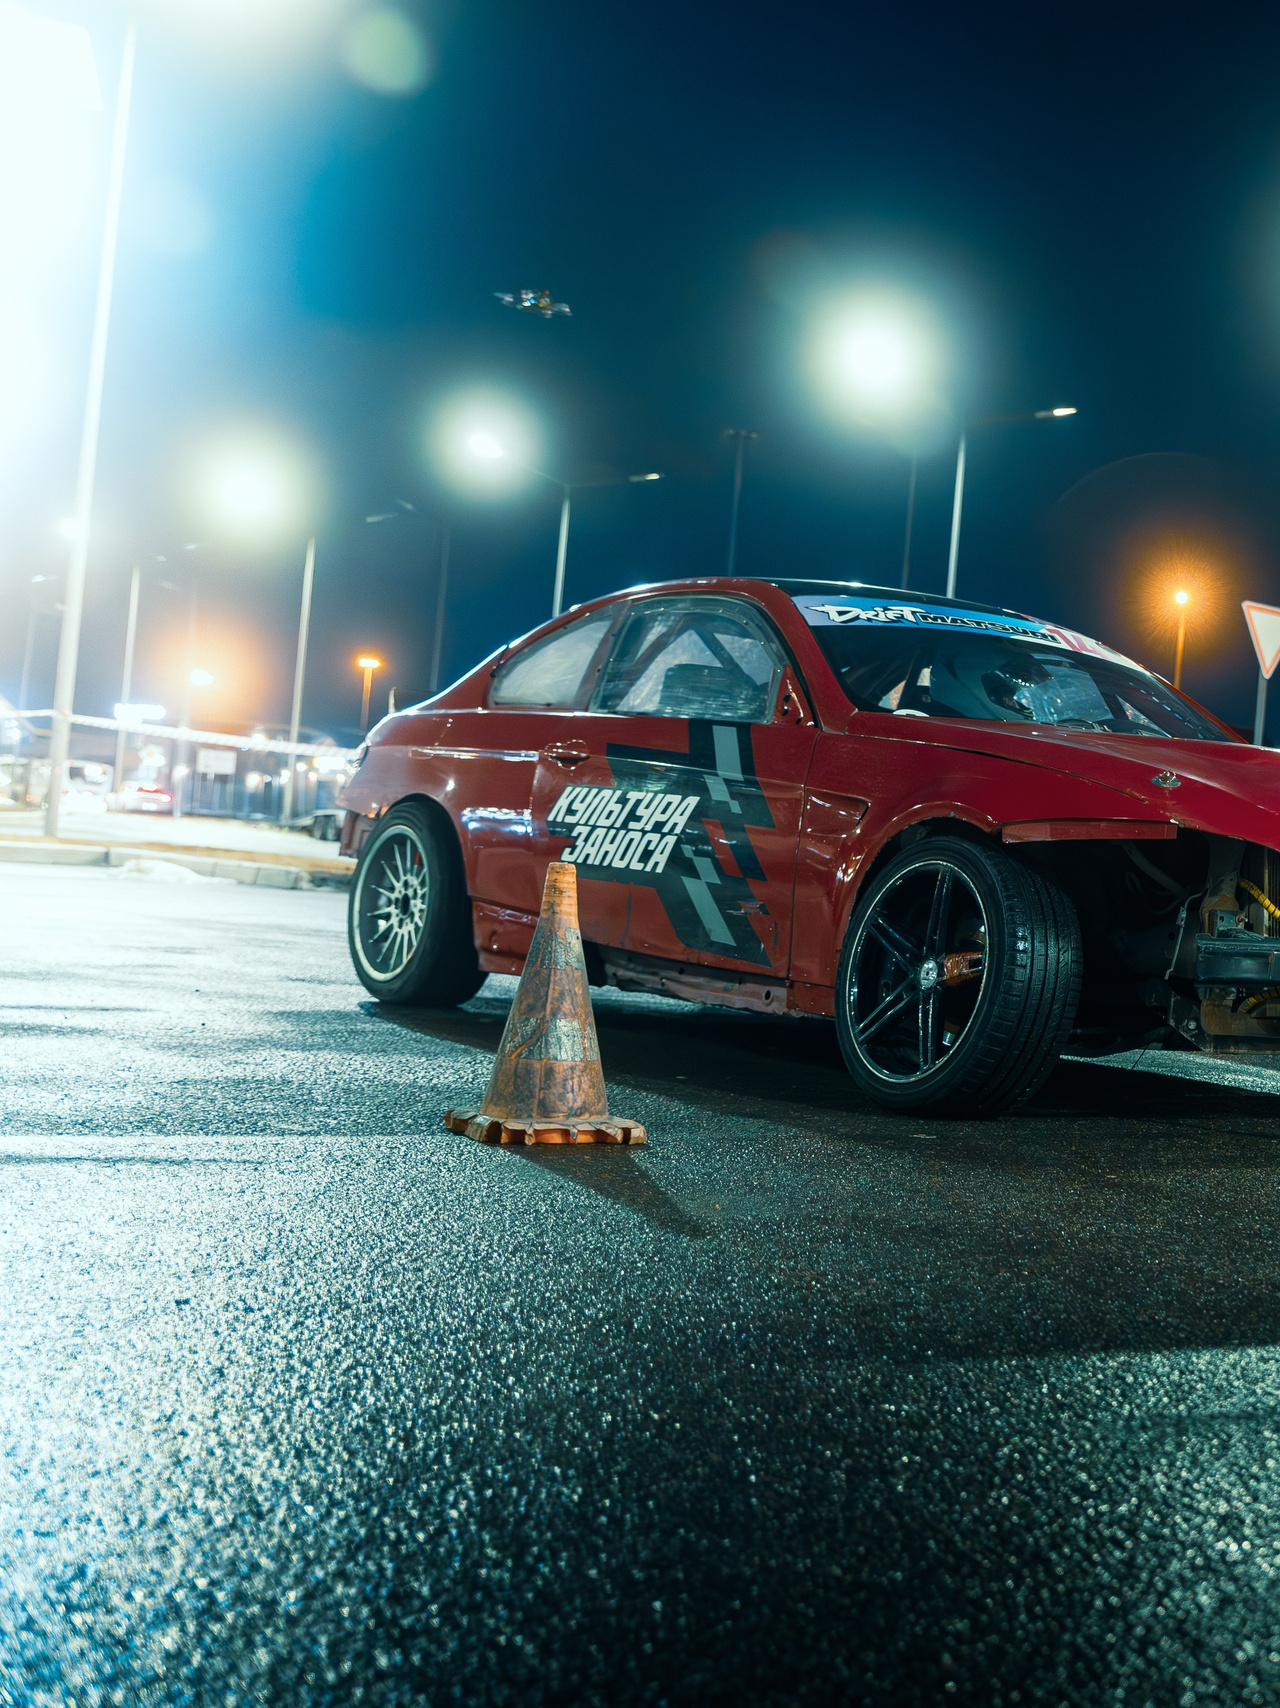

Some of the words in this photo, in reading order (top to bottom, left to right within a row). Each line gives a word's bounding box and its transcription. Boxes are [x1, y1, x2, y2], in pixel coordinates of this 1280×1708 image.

[918, 612, 1062, 645] MATSURI
[547, 786, 700, 834] КУЛЬТУРА
[560, 825, 677, 873] ЗАНОСА
